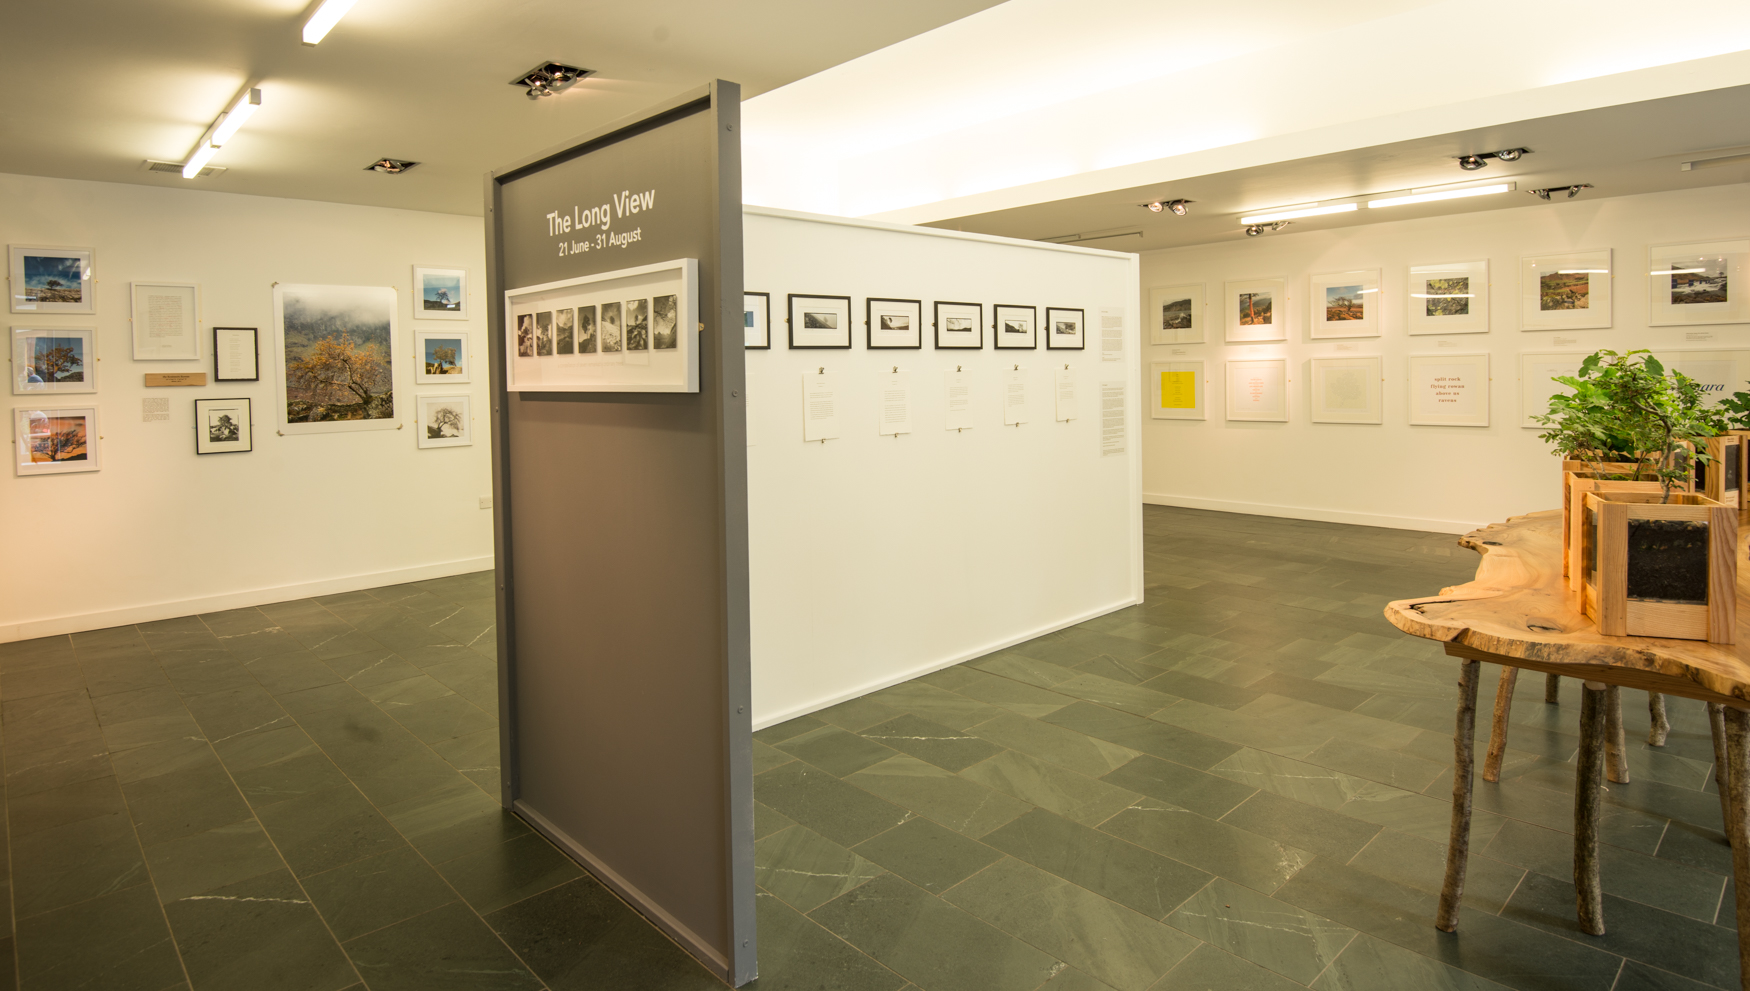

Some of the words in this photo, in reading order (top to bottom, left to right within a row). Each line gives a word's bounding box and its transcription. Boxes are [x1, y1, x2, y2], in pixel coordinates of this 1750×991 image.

[546, 210, 571, 236] The
[574, 203, 610, 230] Long
[613, 189, 655, 219] View
[558, 241, 568, 257] 21
[570, 240, 589, 254] June
[595, 233, 606, 250] 31
[608, 227, 641, 248] August
